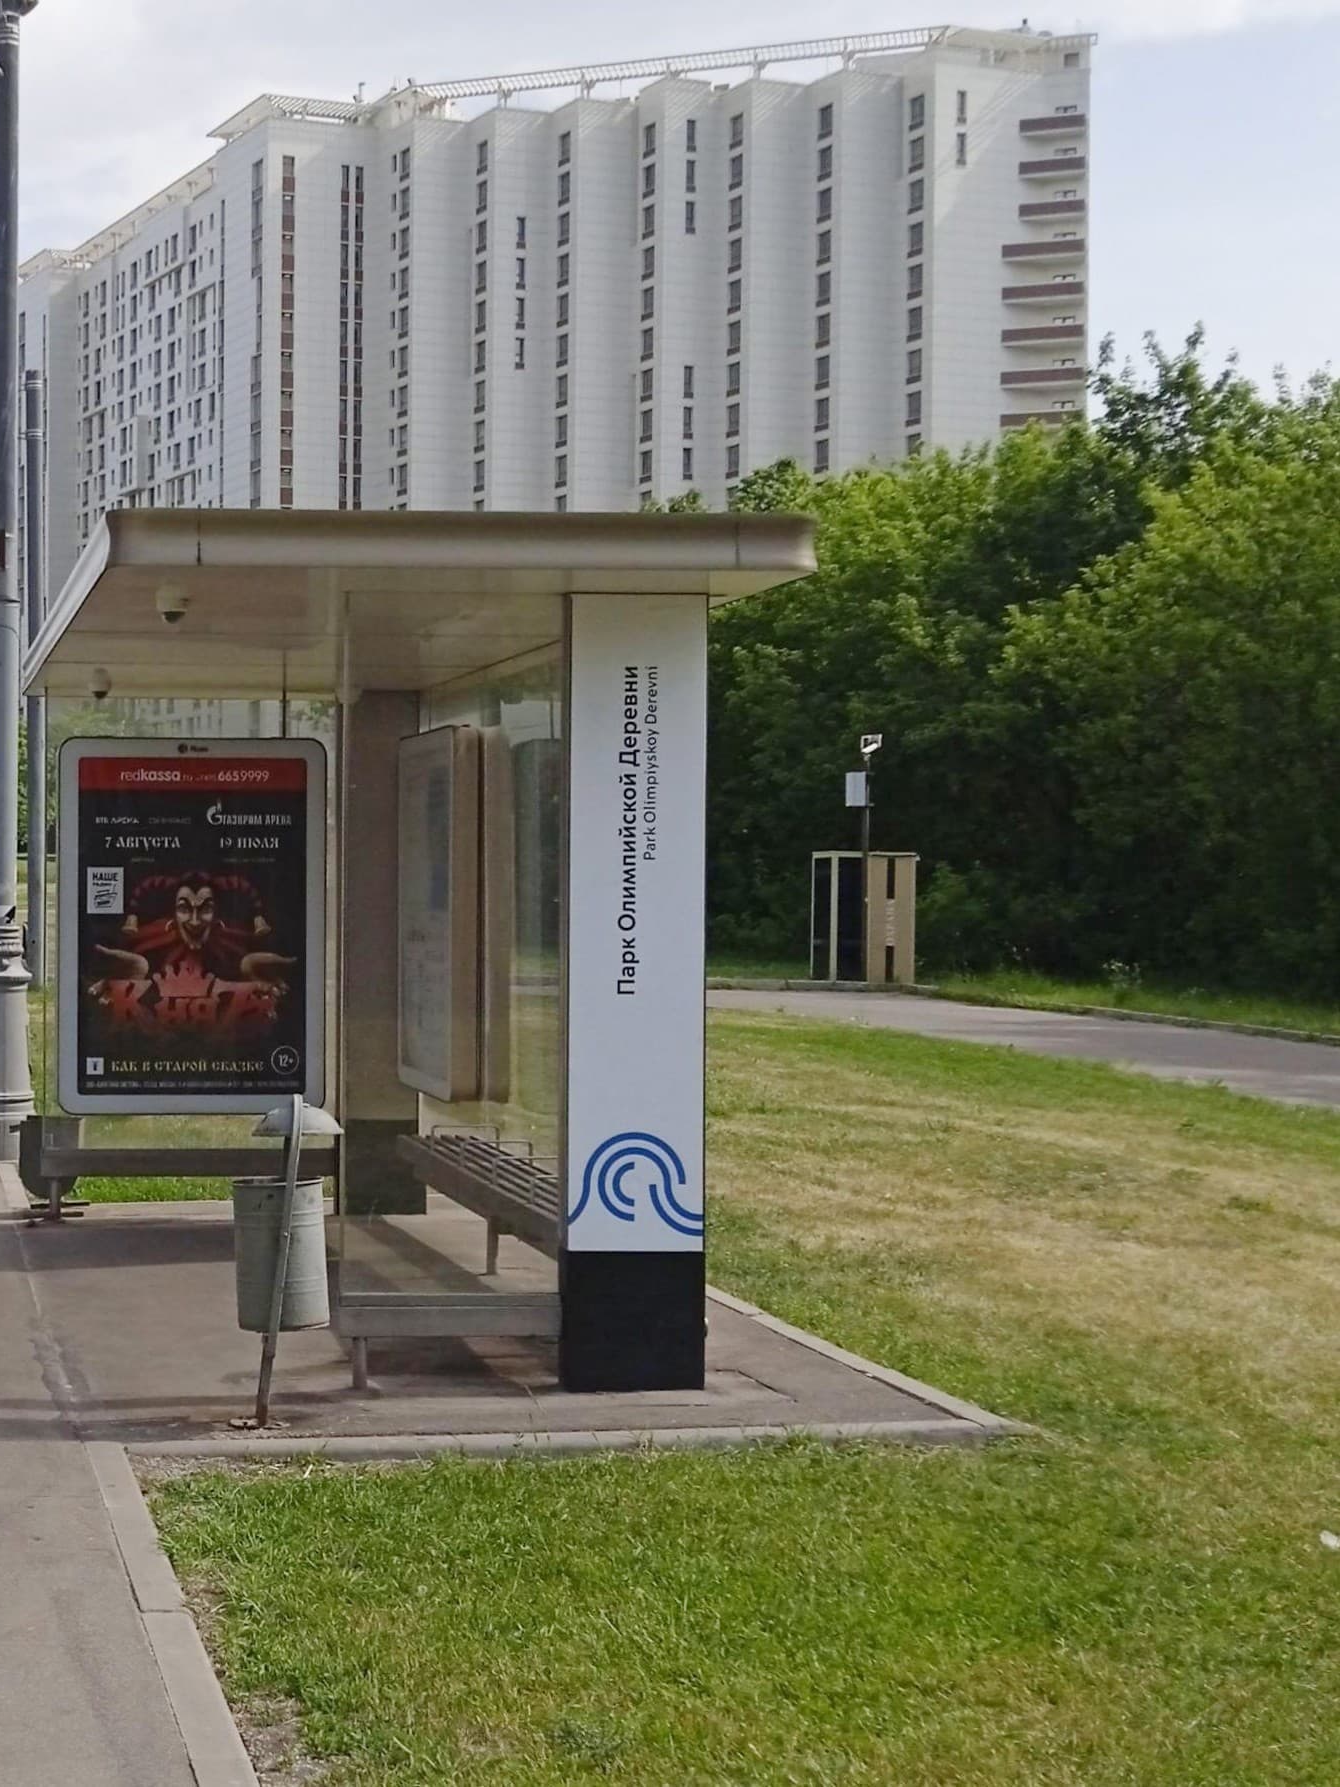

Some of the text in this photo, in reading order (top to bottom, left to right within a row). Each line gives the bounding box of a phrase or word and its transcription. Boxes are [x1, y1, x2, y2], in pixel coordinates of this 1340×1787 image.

[643, 666, 659, 860] Park Olimpiyskoy Derevni
[218, 770, 269, 782] 6659999
[617, 666, 641, 995] Парк Олимпийской Деревни
[105, 836, 181, 851] 7 АВГУСТА
[237, 837, 279, 848] ИЮЛЯ
[92, 871, 119, 881] НАШЕ
[111, 1060, 264, 1072] КАК В СТАРОЙ СКАЗКЕ
[278, 1054, 294, 1067] 12+
